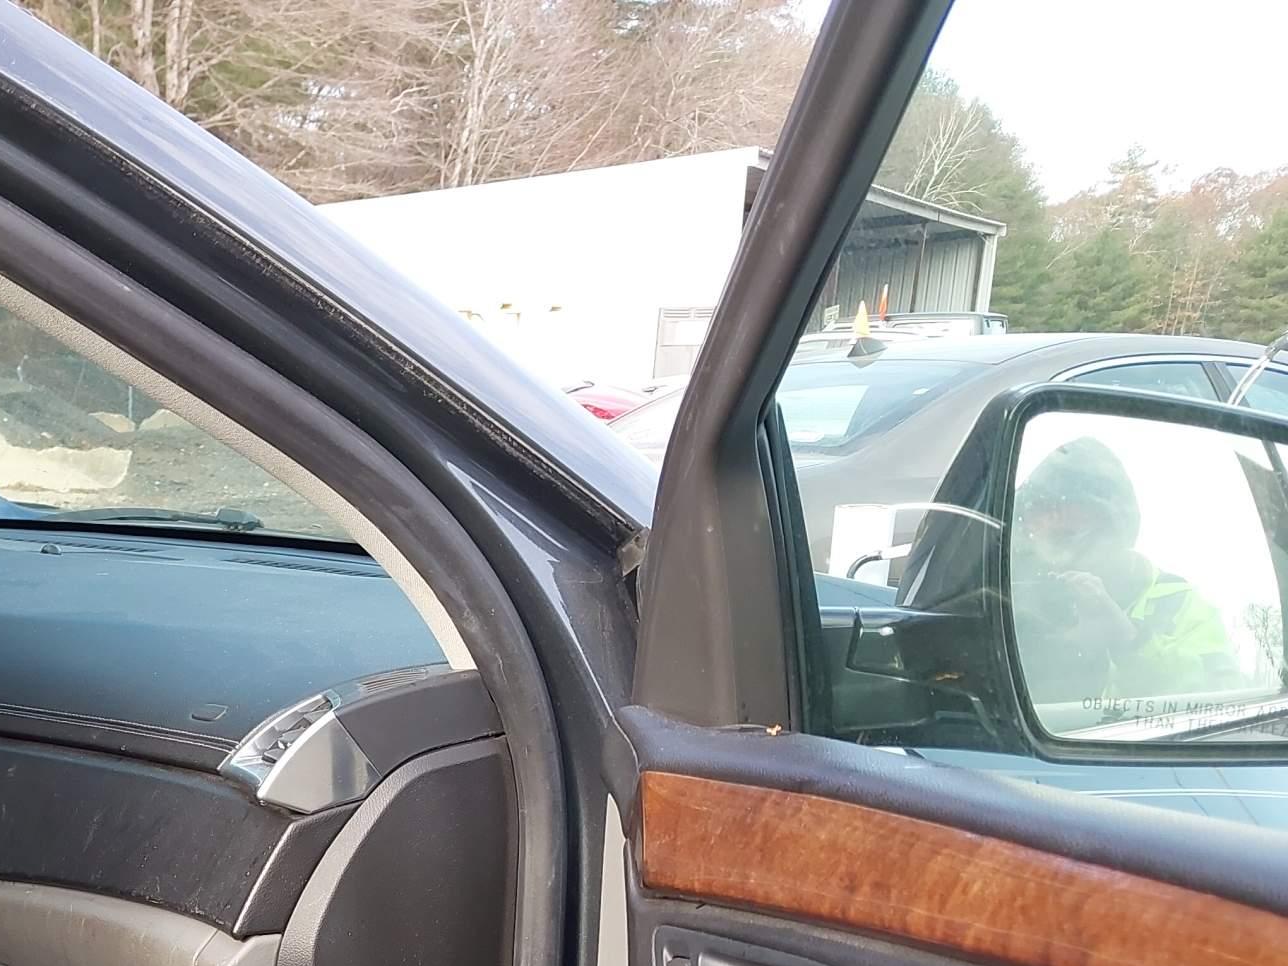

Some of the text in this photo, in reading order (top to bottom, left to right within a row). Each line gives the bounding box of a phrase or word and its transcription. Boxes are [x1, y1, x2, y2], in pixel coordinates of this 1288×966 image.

[1082, 696, 1155, 713] OBJECTS
[1162, 700, 1177, 714] IN
[1186, 702, 1246, 717] MIRROR
[1134, 714, 1175, 729] THAN
